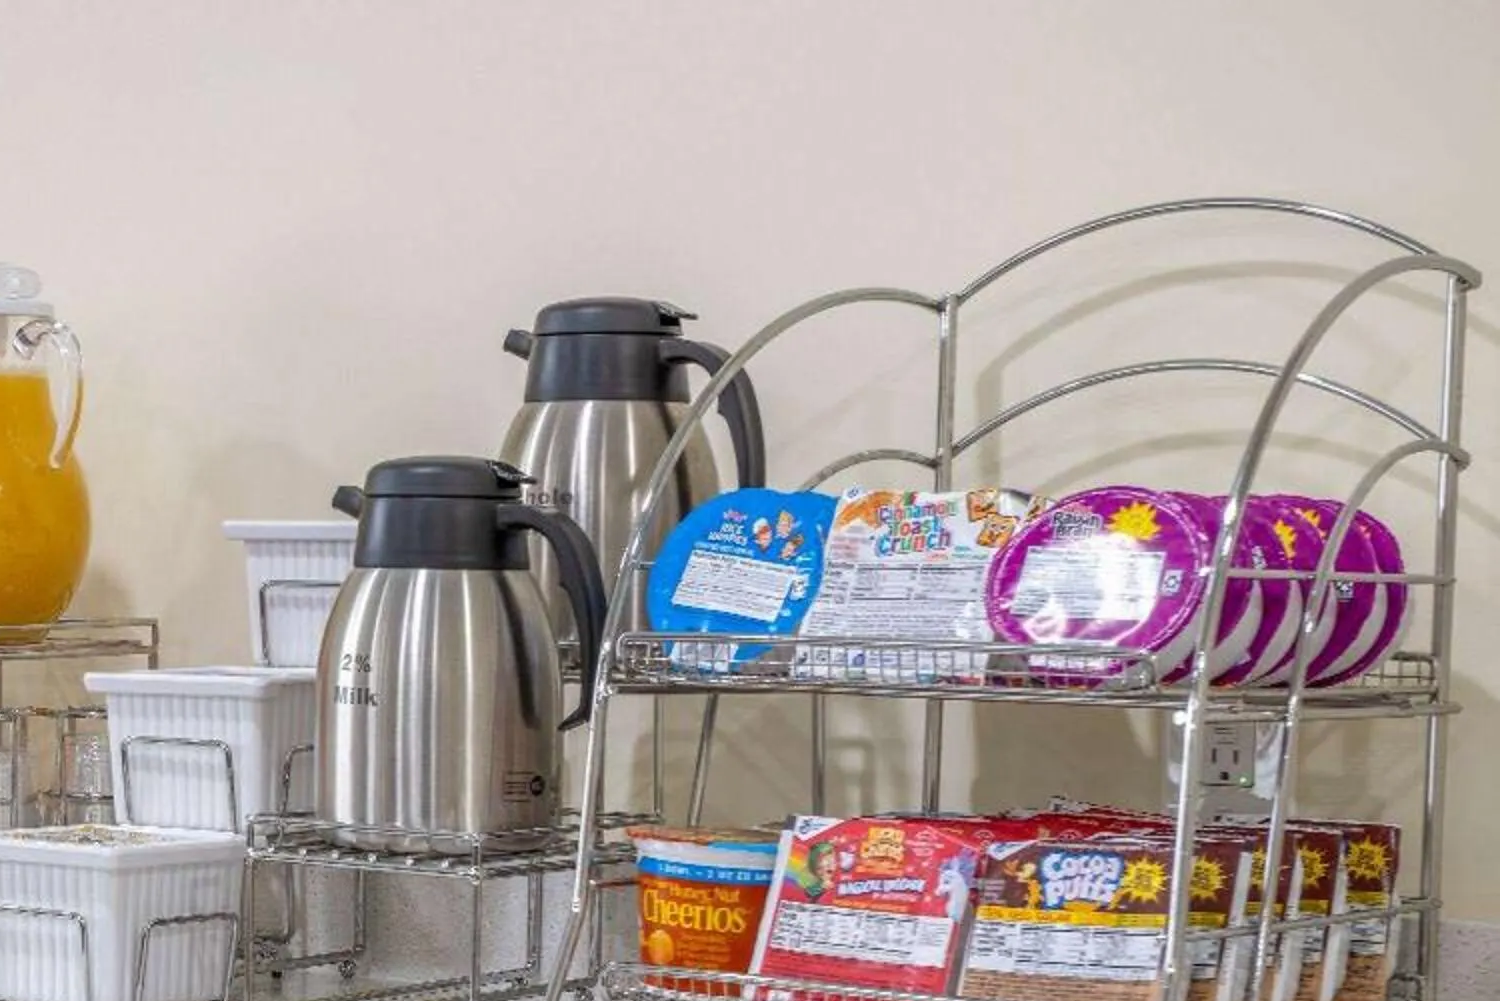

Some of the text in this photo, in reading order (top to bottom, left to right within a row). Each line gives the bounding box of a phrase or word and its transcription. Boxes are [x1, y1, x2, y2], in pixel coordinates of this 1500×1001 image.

[525, 487, 573, 505] hole
[875, 528, 953, 559] Crunch
[341, 652, 372, 673] 2%
[333, 686, 380, 707] Milk
[1042, 852, 1123, 882] Cocoa
[715, 887, 741, 903] Nut
[1044, 872, 1119, 909] Puffs
[643, 889, 748, 934] Cheerios
